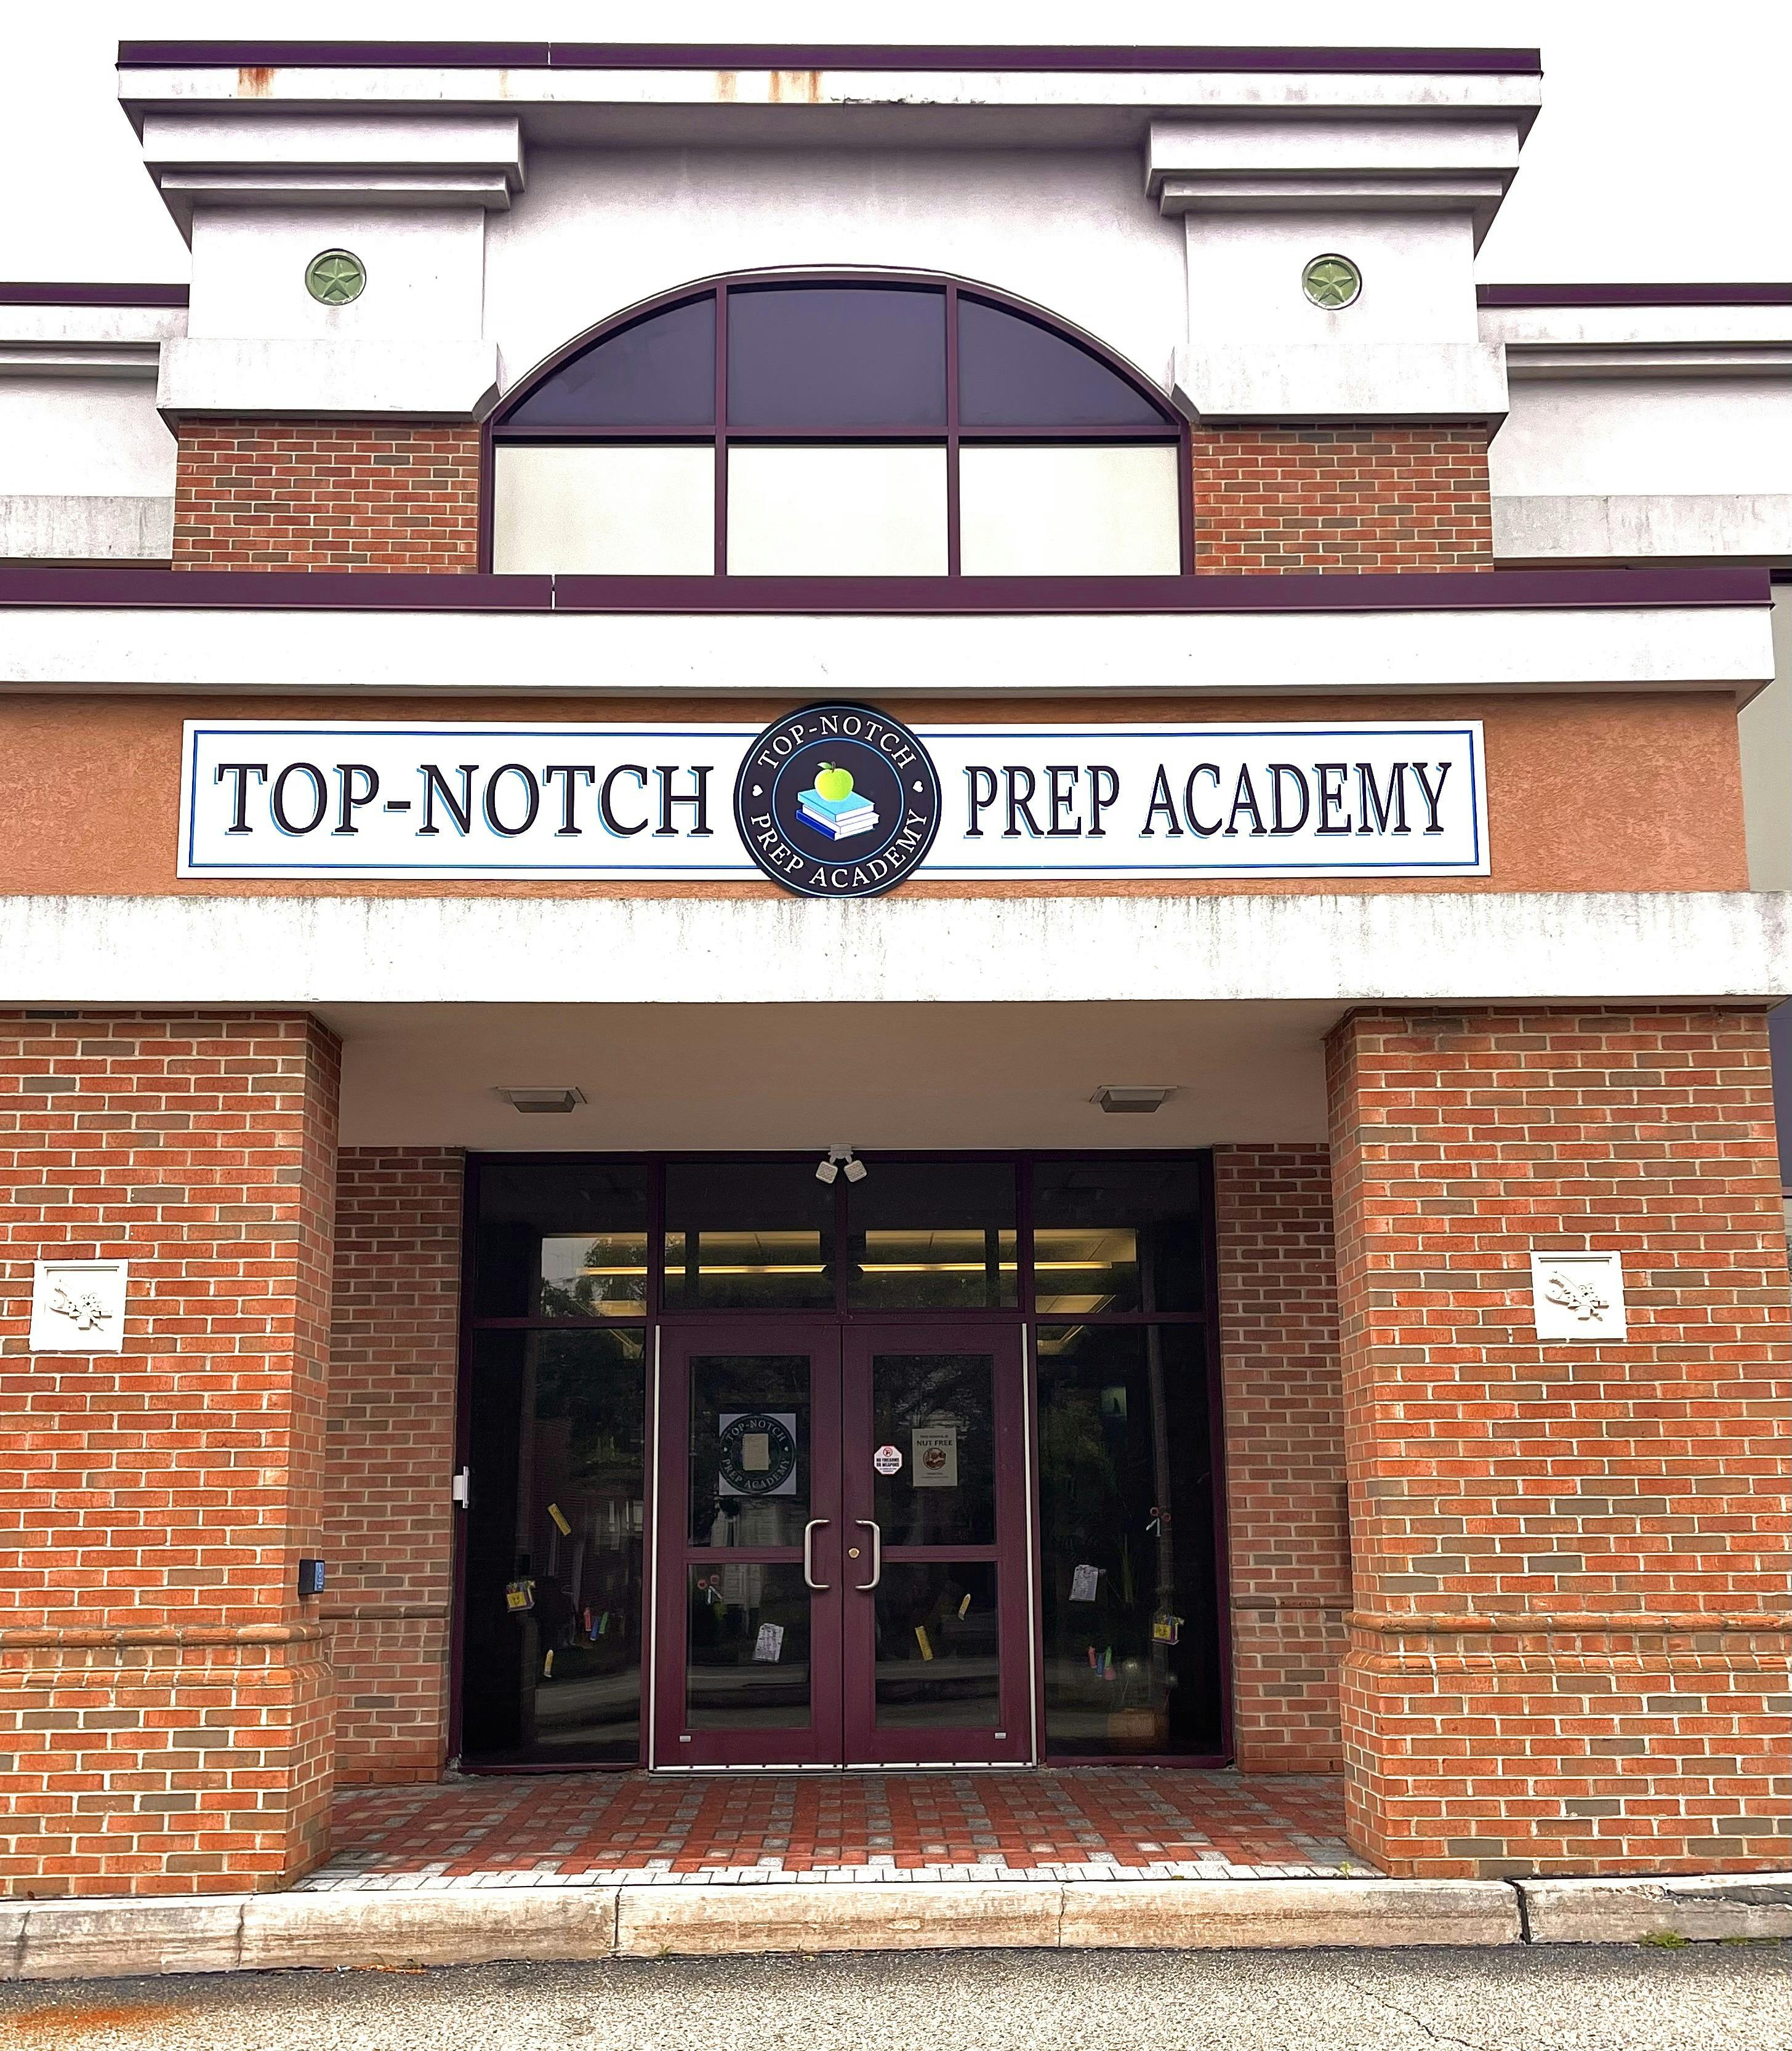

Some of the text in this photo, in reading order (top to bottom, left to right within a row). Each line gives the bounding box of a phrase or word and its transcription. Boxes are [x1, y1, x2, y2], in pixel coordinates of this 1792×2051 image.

[758, 715, 916, 769] TOP-NOTCH
[215, 762, 1452, 839] TOP-NOTCH PREP ACADEMY
[750, 808, 927, 888] PREP ACADEMY
[726, 1420, 786, 1442] TOP-NOTCH
[723, 1458, 789, 1488] PREP ACADEMY
